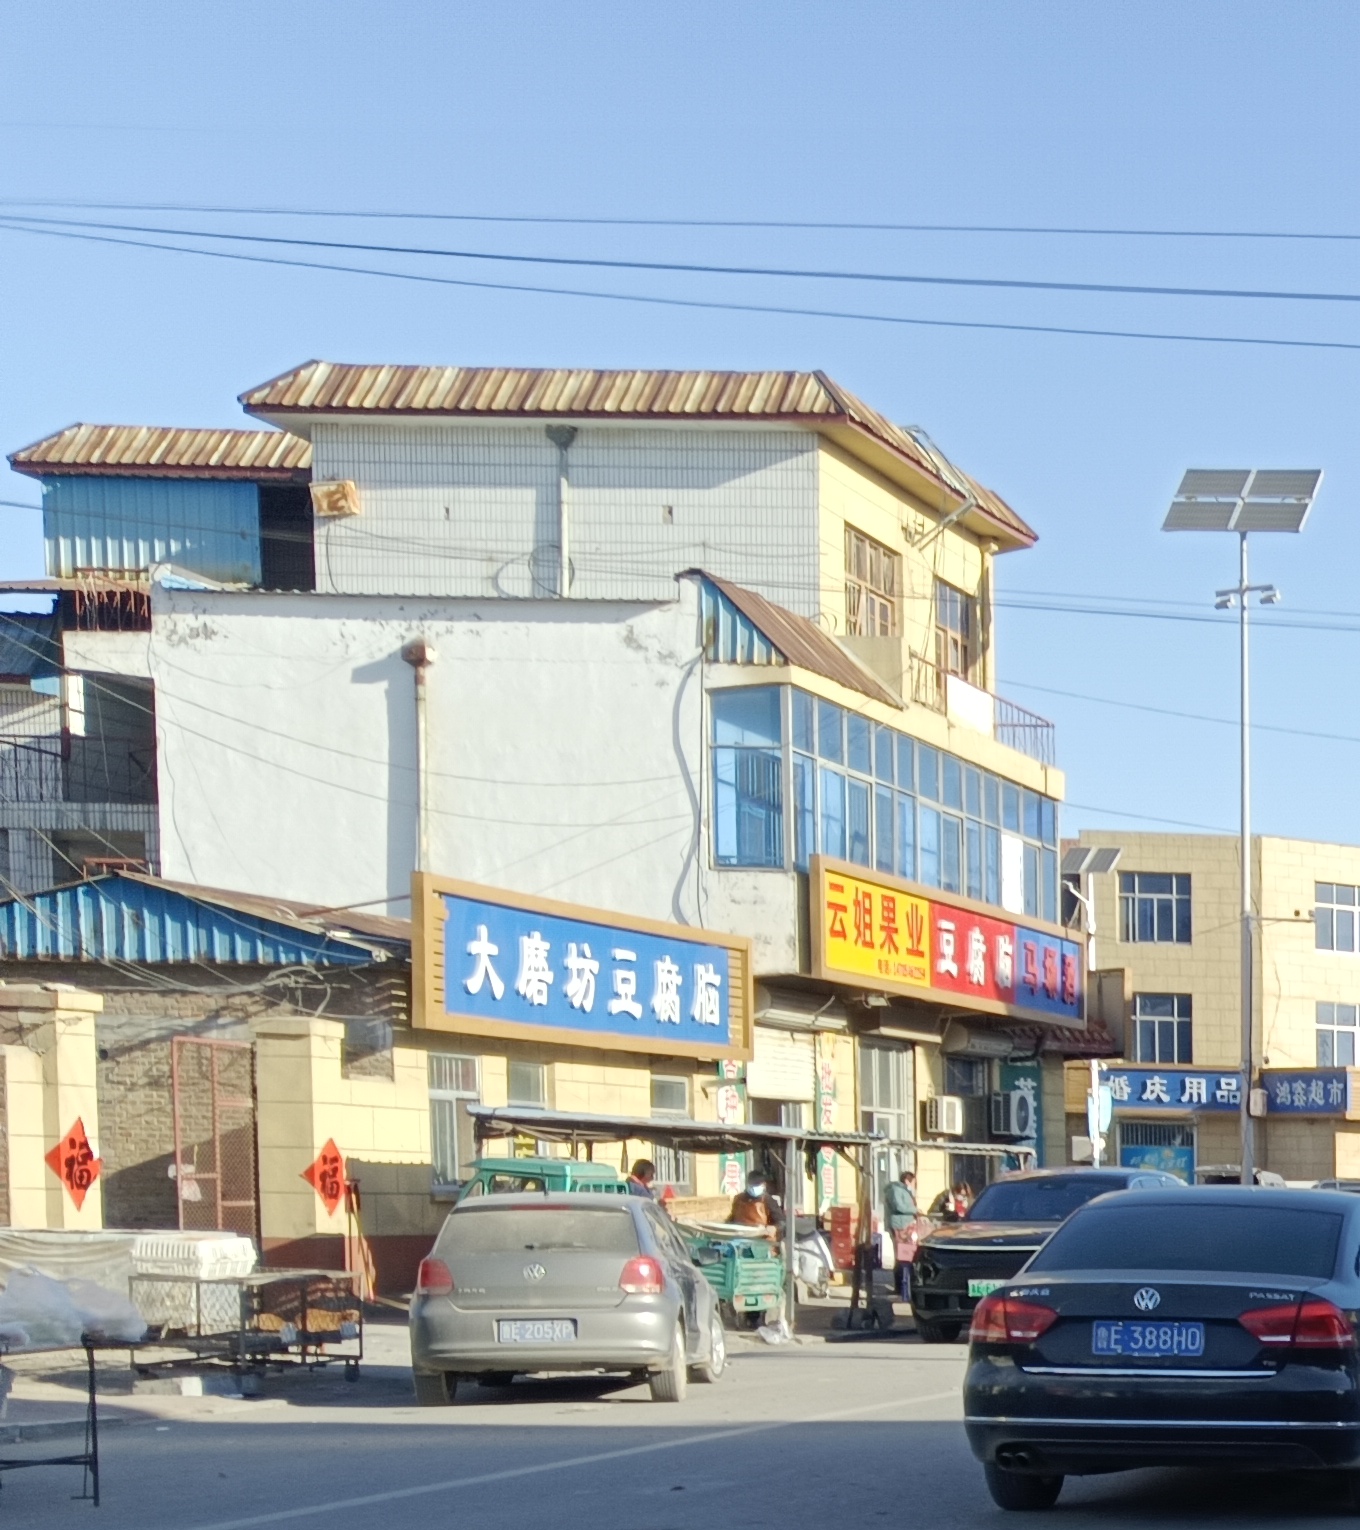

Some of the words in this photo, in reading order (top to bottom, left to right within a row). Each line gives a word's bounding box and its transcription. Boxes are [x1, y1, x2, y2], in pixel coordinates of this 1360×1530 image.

[827, 881, 925, 958] 云姐果业
[936, 918, 1013, 989] 豆腐脑
[463, 924, 722, 1026] 大磨坊豆腐脑
[1108, 1074, 1241, 1105] 婚庆用品
[1275, 1078, 1345, 1108] 鸿鑫超市
